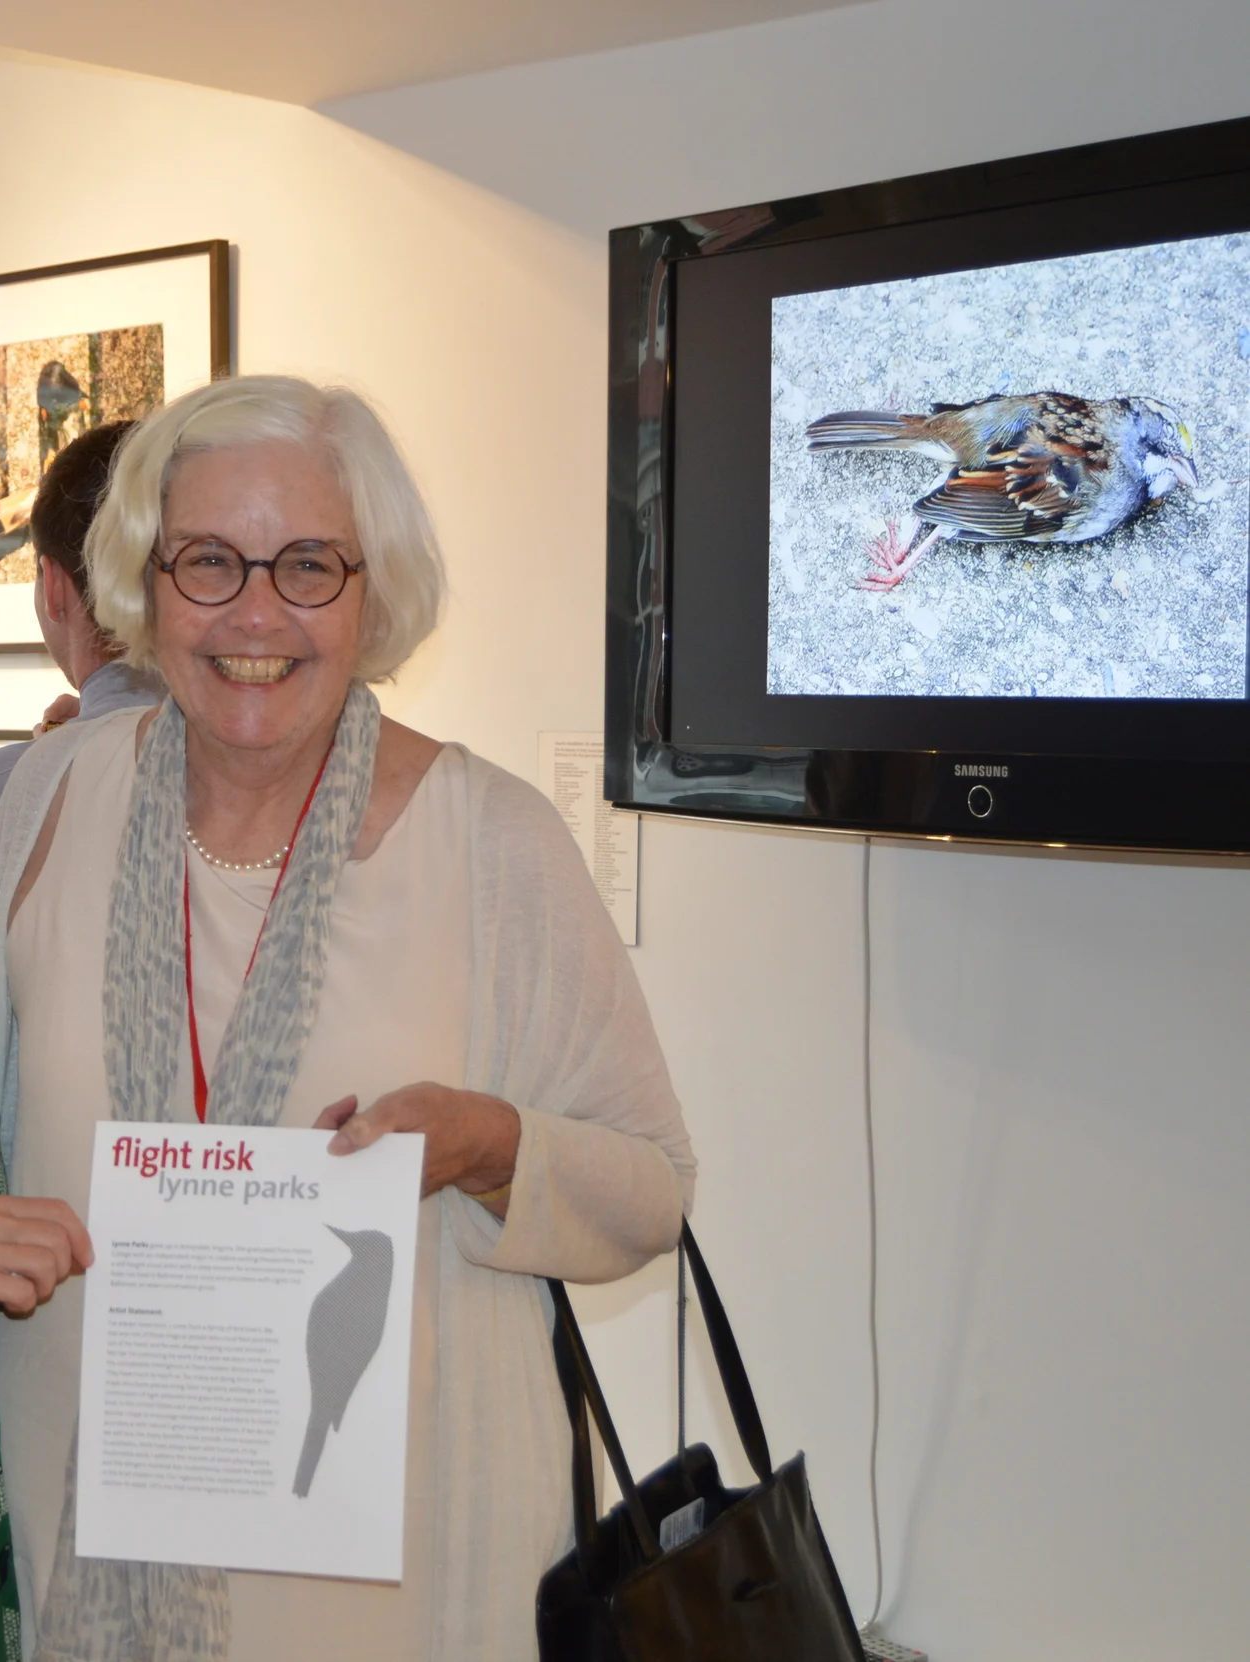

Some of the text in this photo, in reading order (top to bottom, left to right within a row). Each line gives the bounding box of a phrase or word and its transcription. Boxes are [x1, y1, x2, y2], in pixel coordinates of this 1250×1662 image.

[954, 764, 1009, 778] SAMSUNG
[112, 1136, 254, 1178] flight risk
[158, 1172, 320, 1204] lynne parks
